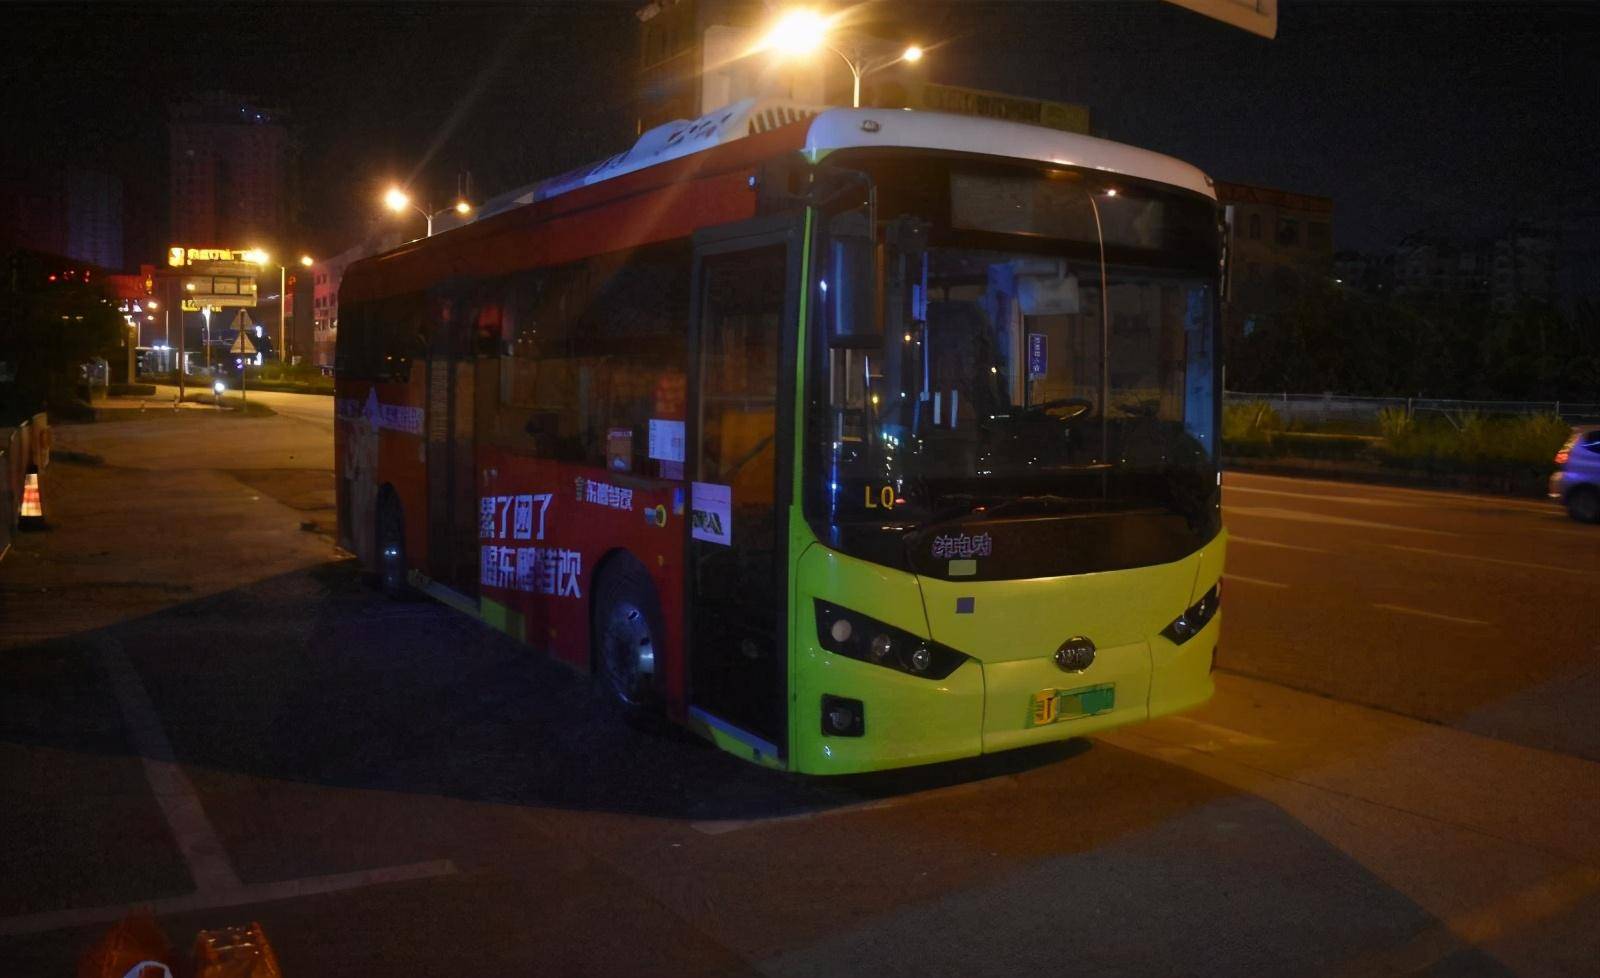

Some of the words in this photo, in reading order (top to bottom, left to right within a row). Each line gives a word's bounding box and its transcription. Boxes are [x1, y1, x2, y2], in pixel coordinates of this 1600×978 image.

[865, 485, 894, 510] LQ
[480, 493, 554, 541] 累了困了
[932, 532, 992, 559] 纯电动
